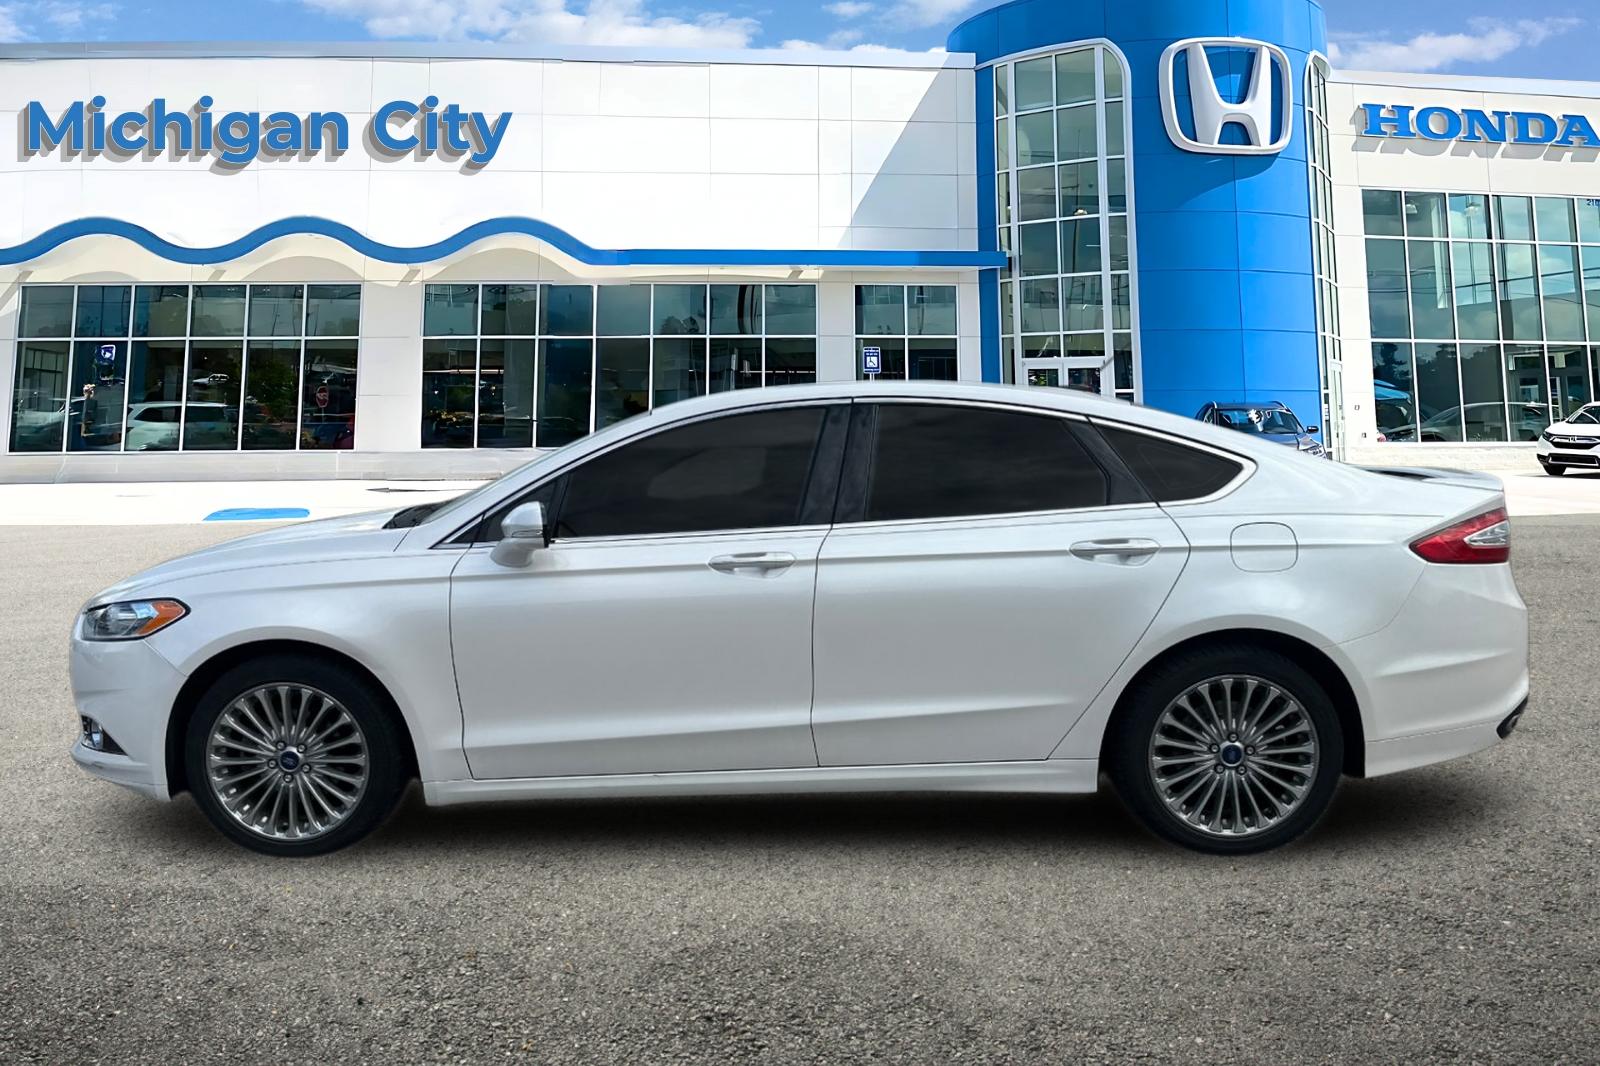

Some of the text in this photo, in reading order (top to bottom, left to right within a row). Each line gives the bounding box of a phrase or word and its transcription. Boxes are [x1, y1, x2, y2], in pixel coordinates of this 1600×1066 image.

[28, 95, 513, 164] Michigan City
[1361, 103, 1600, 148] HONDA
